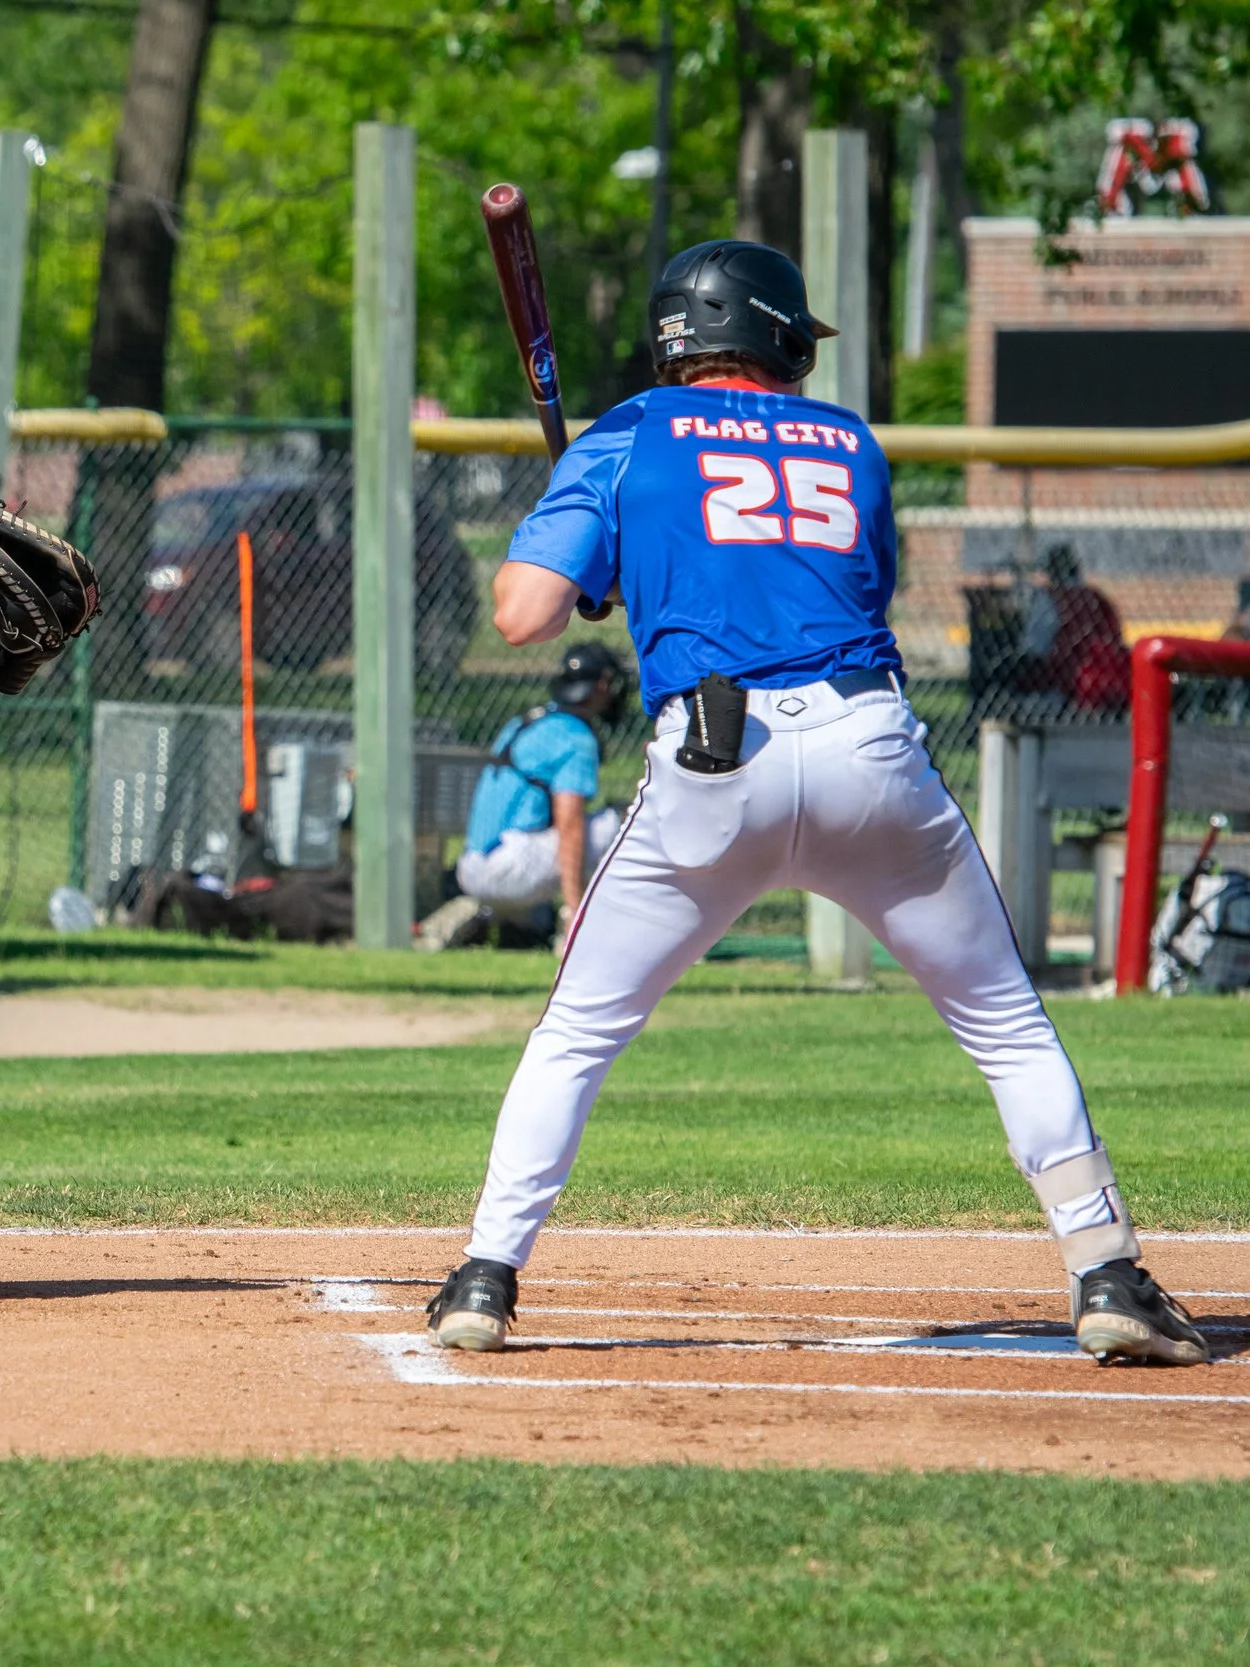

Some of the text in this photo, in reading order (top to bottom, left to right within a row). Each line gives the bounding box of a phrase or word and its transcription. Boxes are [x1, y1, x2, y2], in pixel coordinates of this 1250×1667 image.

[671, 416, 859, 453] FLAG CITY
[698, 451, 860, 553] 25
